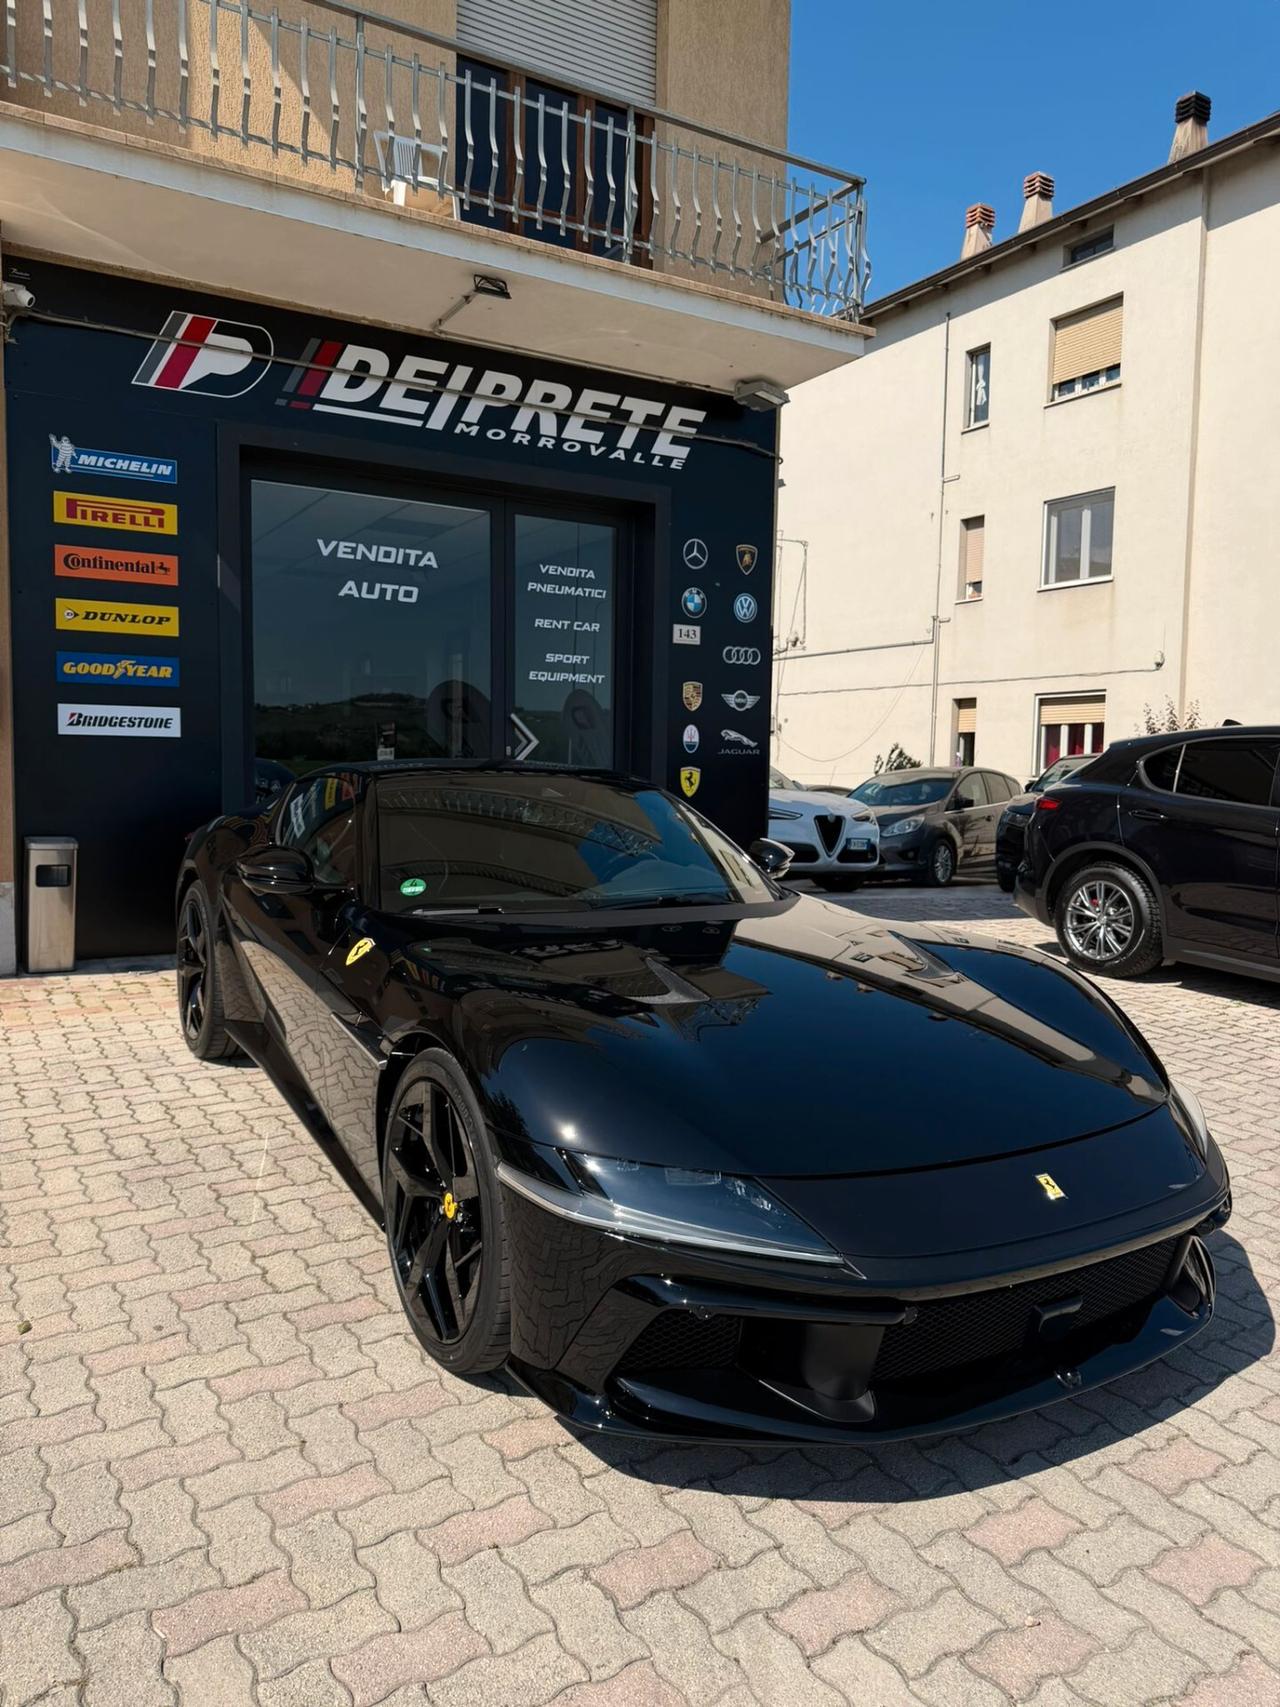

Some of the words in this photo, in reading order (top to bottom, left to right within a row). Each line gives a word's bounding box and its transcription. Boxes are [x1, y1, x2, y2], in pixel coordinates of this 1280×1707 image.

[454, 423, 688, 470] MORROVALLE
[77, 454, 172, 476] MICHELIN
[66, 497, 165, 529] PIRELLI
[316, 538, 439, 569] VENDITA
[62, 552, 156, 575] Continental
[539, 564, 596, 580] VENDITA
[338, 580, 419, 603] AUTO
[527, 582, 607, 599] PNEUMATICI
[81, 610, 171, 626] DUNLOP
[534, 618, 571, 631] RENT
[573, 621, 601, 632] CAR
[678, 628, 697, 640] 143
[545, 653, 590, 665] SPORT
[63, 660, 173, 679] GOODYEAR
[528, 670, 605, 685] EQUIPMENT
[66, 712, 173, 730] BRIDGESTONE
[718, 748, 761, 756] JAGUAR
